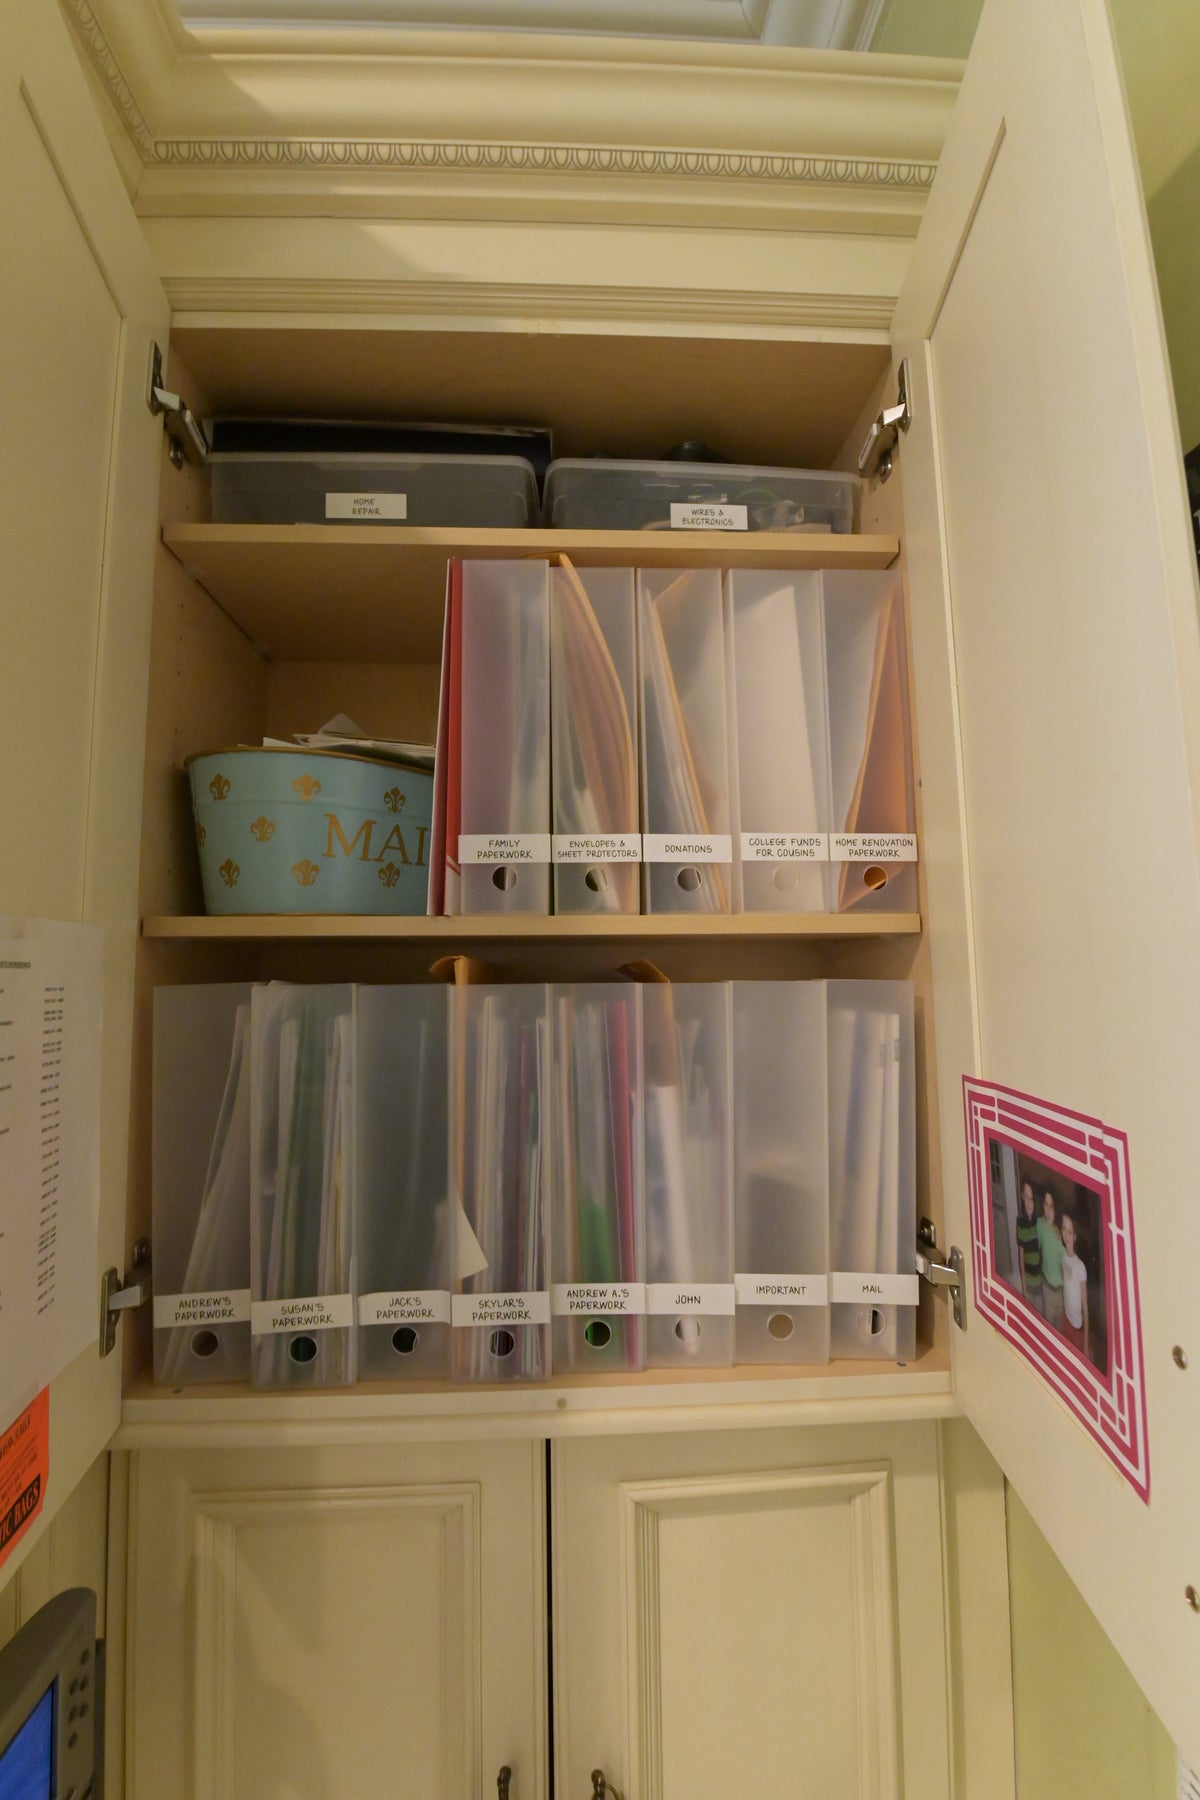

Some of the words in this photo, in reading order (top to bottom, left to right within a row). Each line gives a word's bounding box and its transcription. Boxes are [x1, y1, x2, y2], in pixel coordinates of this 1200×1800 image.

[353, 497, 375, 506] HOME
[352, 507, 382, 516] REPAIR
[691, 508, 716, 517] WIRES
[718, 508, 725, 517] &
[682, 517, 734, 527] ELECTRONICS
[321, 813, 430, 867] MAI
[488, 839, 521, 848] FAMILY
[569, 840, 616, 848] ENVELOPES
[619, 840, 626, 848] &
[748, 837, 787, 847] COLLEGE
[791, 838, 822, 847] FUNDS
[835, 838, 858, 847] HOME
[862, 838, 914, 848] RENOVATION
[664, 844, 713, 854] DONATIONS
[755, 848, 774, 858] FOR
[777, 848, 815, 858] COUSINS
[848, 848, 901, 858] PAPERWORK
[477, 850, 533, 860] PAPERWORK
[557, 850, 582, 859] SHEET
[586, 850, 638, 859] PROTECTORS
[566, 1289, 608, 1299] ANDREW
[756, 1285, 807, 1296] IMPORTANT
[862, 1285, 883, 1295] MAIL
[178, 1296, 232, 1309] ANDREW'S
[389, 1297, 422, 1307] JACK'S
[478, 1298, 525, 1310] SKYLAR'S
[675, 1294, 701, 1305] JOHN
[280, 1302, 325, 1316] SUSAN'S
[569, 1300, 628, 1311] PAPERWORK
[174, 1308, 236, 1322] PAPERWORK
[376, 1308, 435, 1320] PAPERWORK
[472, 1310, 532, 1322] PAPERWORK
[272, 1314, 335, 1329] PAPERWORK
[14, 1481, 39, 1526] BAGS
